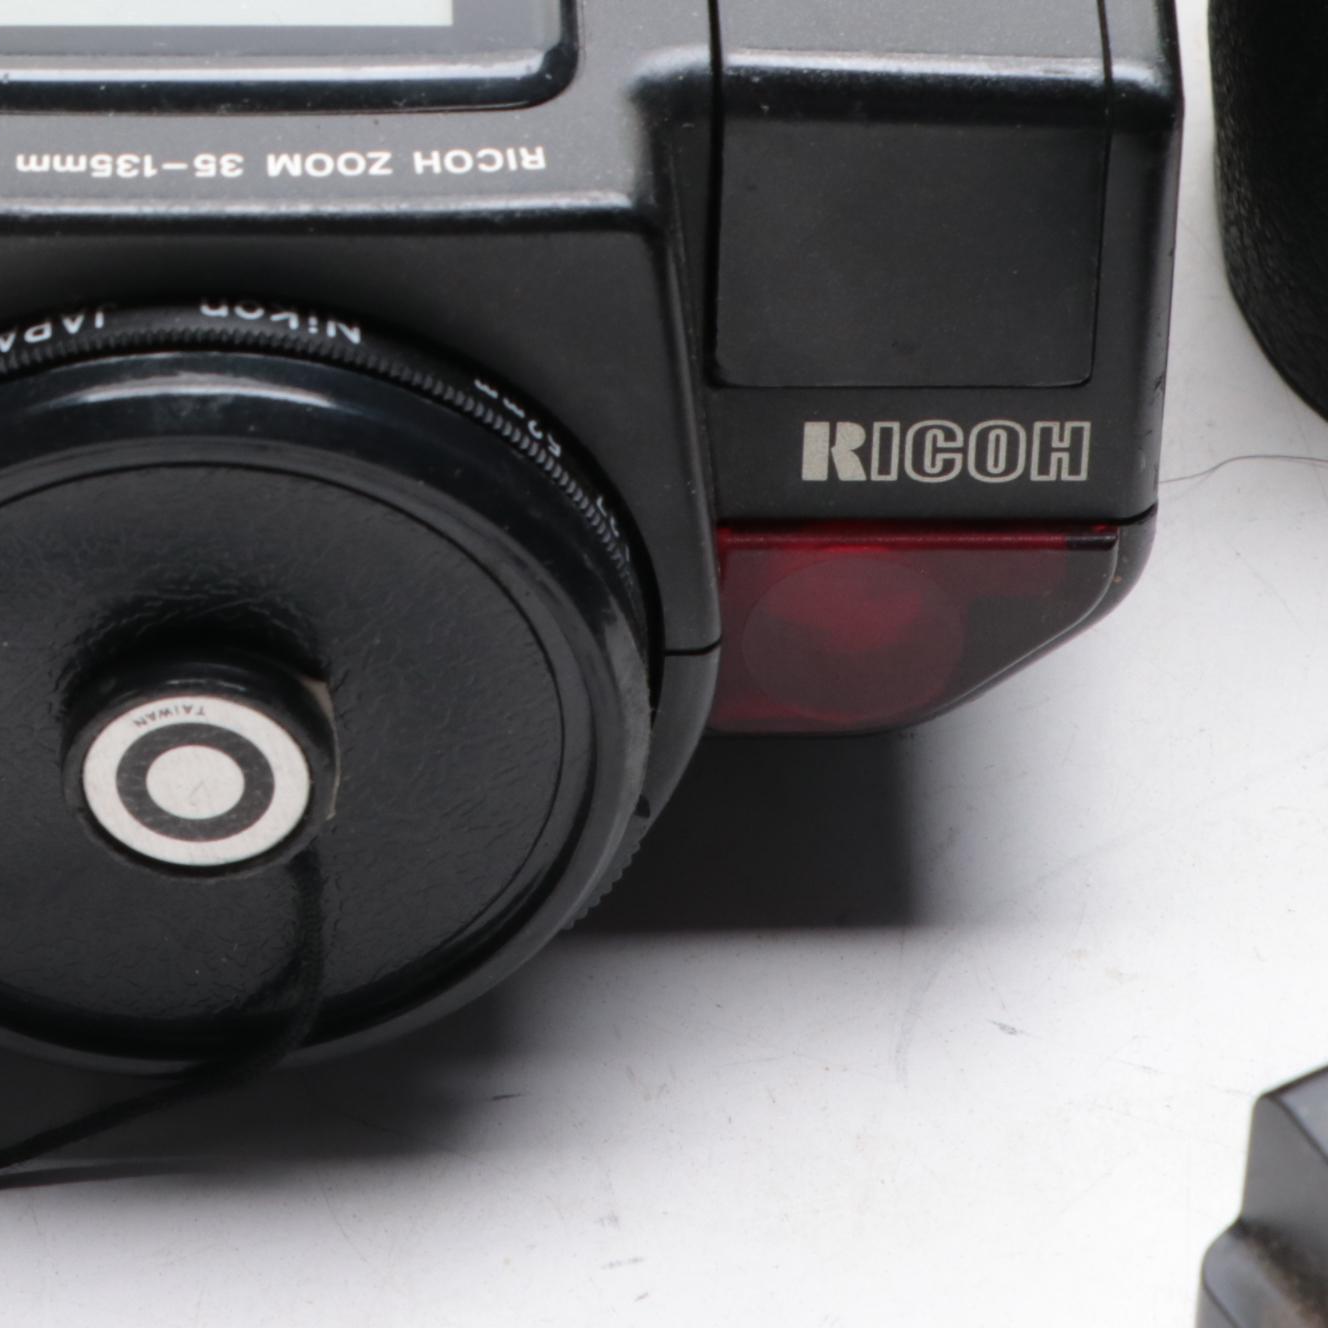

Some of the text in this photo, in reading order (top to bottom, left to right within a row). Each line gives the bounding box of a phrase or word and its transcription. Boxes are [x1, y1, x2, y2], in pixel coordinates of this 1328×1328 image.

[267, 150, 394, 178] ZOOM
[415, 145, 547, 175] RICOH
[801, 420, 1091, 483] RICOH
[132, 703, 207, 728] TAIWAN
